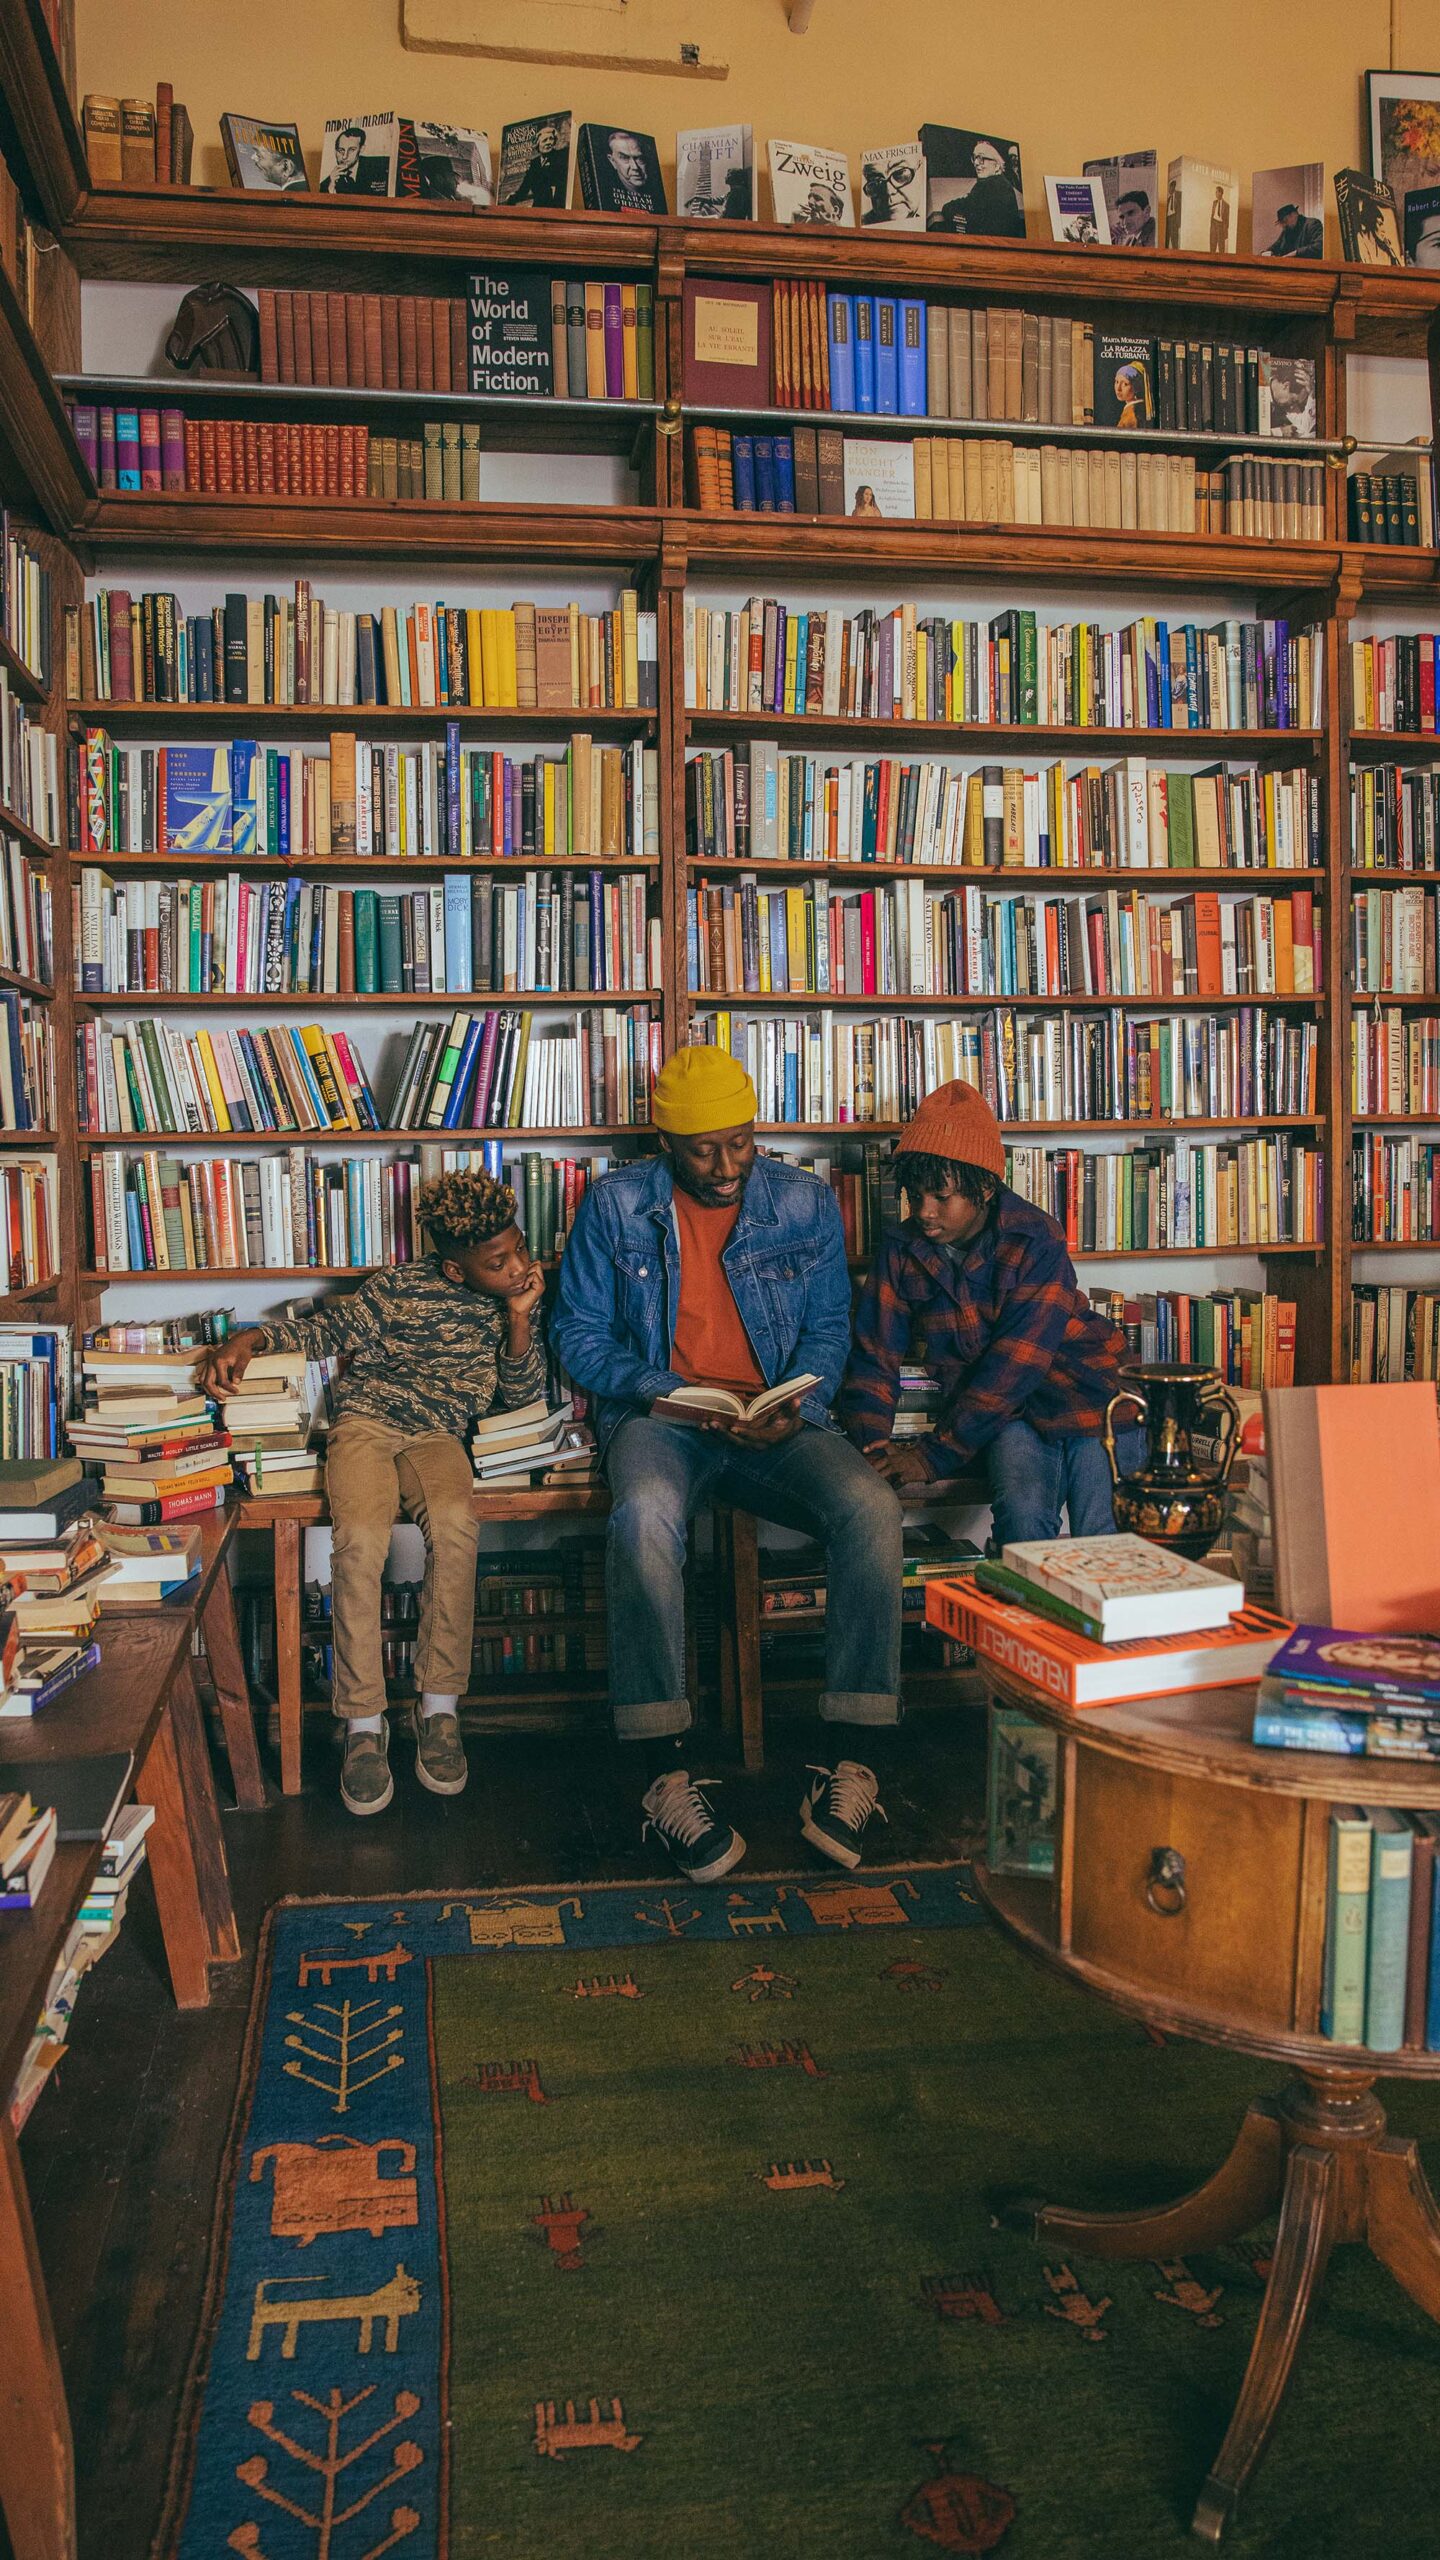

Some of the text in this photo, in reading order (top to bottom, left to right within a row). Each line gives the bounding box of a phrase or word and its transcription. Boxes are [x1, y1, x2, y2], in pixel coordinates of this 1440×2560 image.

[863, 145, 918, 162] MAX FRISCH
[776, 151, 846, 192] Zweig
[613, 193, 652, 205] GRAHAM
[615, 200, 654, 211] GREENE
[470, 276, 509, 295] The
[471, 299, 528, 319] World
[472, 321, 492, 340] of
[473, 345, 549, 366] Modern
[1114, 352, 1150, 360] TURBANTE
[1115, 345, 1147, 354] RAGAZZA
[474, 370, 539, 391] Fiction
[810, 633, 825, 671] Temptation
[1311, 778, 1319, 833] KIM STANLEY ROBINSON
[192, 890, 200, 931] BOGMAIL
[415, 897, 425, 962] WHITE JACKET
[318, 1055, 338, 1103] HENRY MILLER
[1054, 1051, 1062, 1088] ESTATE
[112, 1168, 123, 1250] COLLECTED WRITINGS
[169, 1492, 212, 1509] THOMAS MANN
[982, 1626, 1069, 1695] NEUBAUWELT
